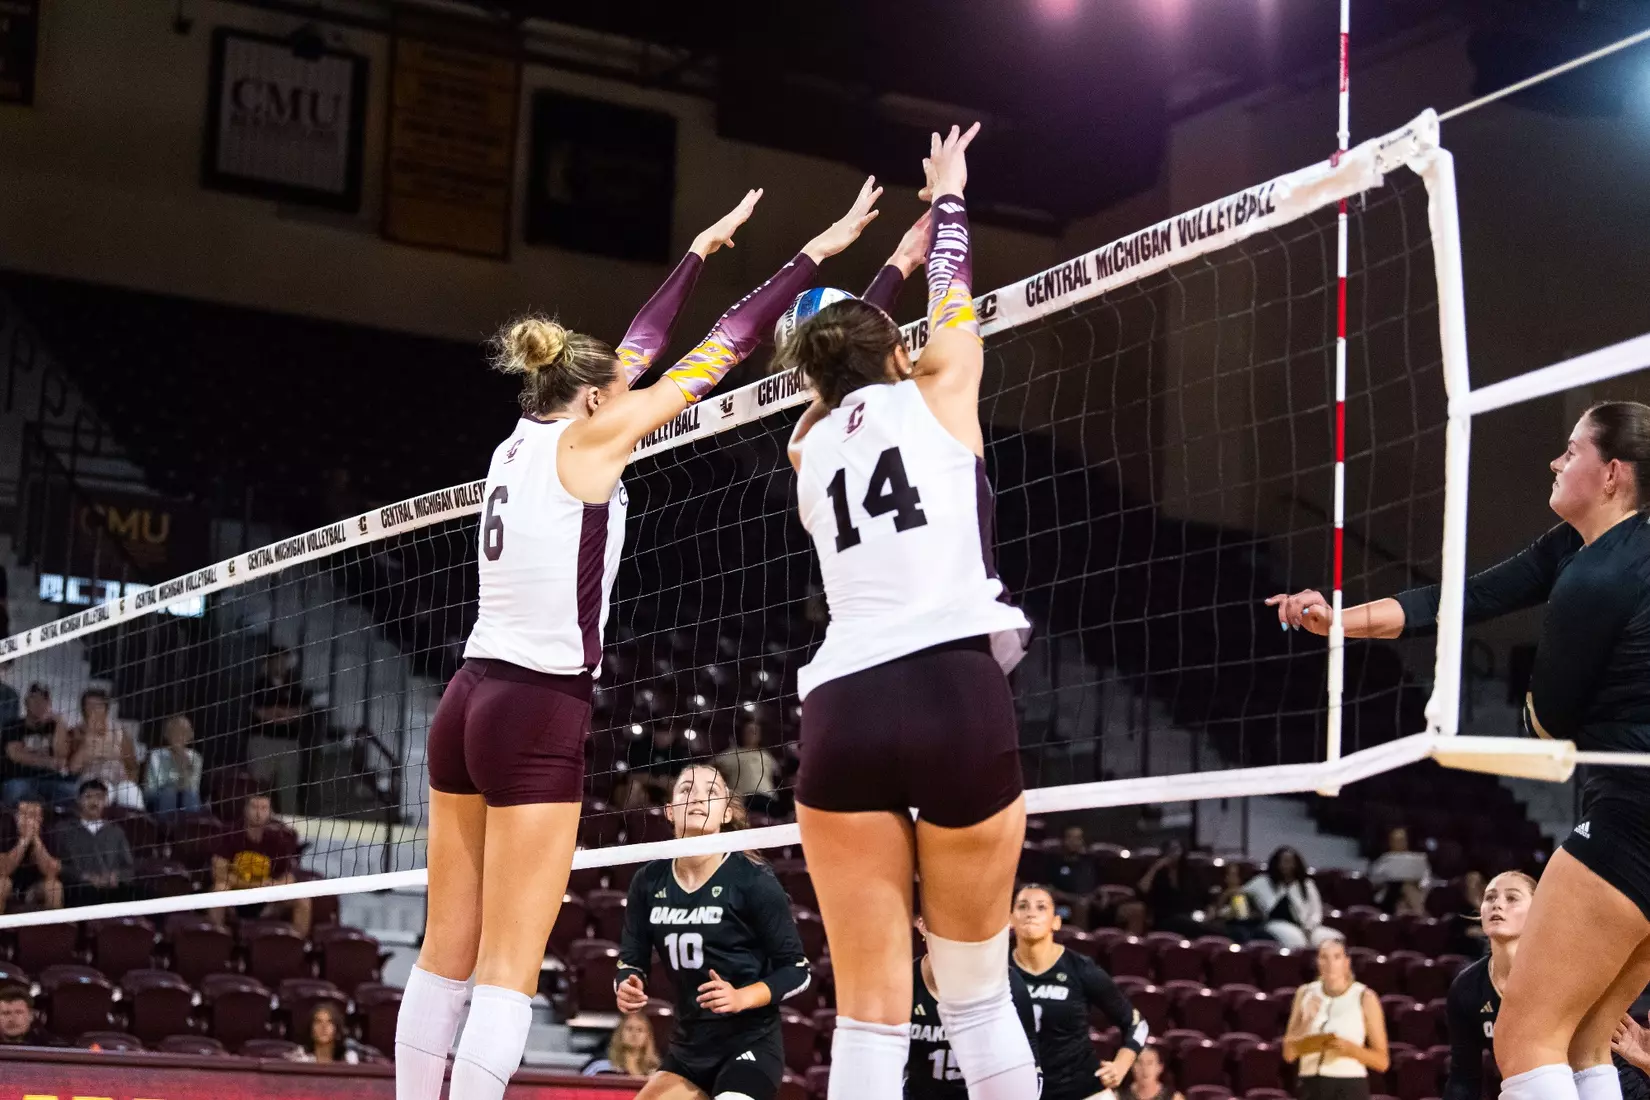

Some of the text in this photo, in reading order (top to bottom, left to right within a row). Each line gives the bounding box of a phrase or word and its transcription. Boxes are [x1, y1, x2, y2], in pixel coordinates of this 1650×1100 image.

[233, 78, 342, 126] CMU
[1025, 183, 1276, 308] CENTRAL MICHIGAN VOLLEYBALL
[758, 369, 807, 407] CENTRAL
[640, 405, 701, 451] VOLLEYBALL
[80, 502, 171, 543] CMU
[381, 501, 413, 528] CENTRAL
[414, 488, 454, 518] MICHIGAN
[826, 446, 928, 554] 14
[483, 485, 509, 562] 6
[247, 552, 274, 571] CENTRAL
[307, 523, 347, 553] VOLLEYBALL
[649, 906, 724, 925] OAKLAND
[664, 932, 704, 971] 10
